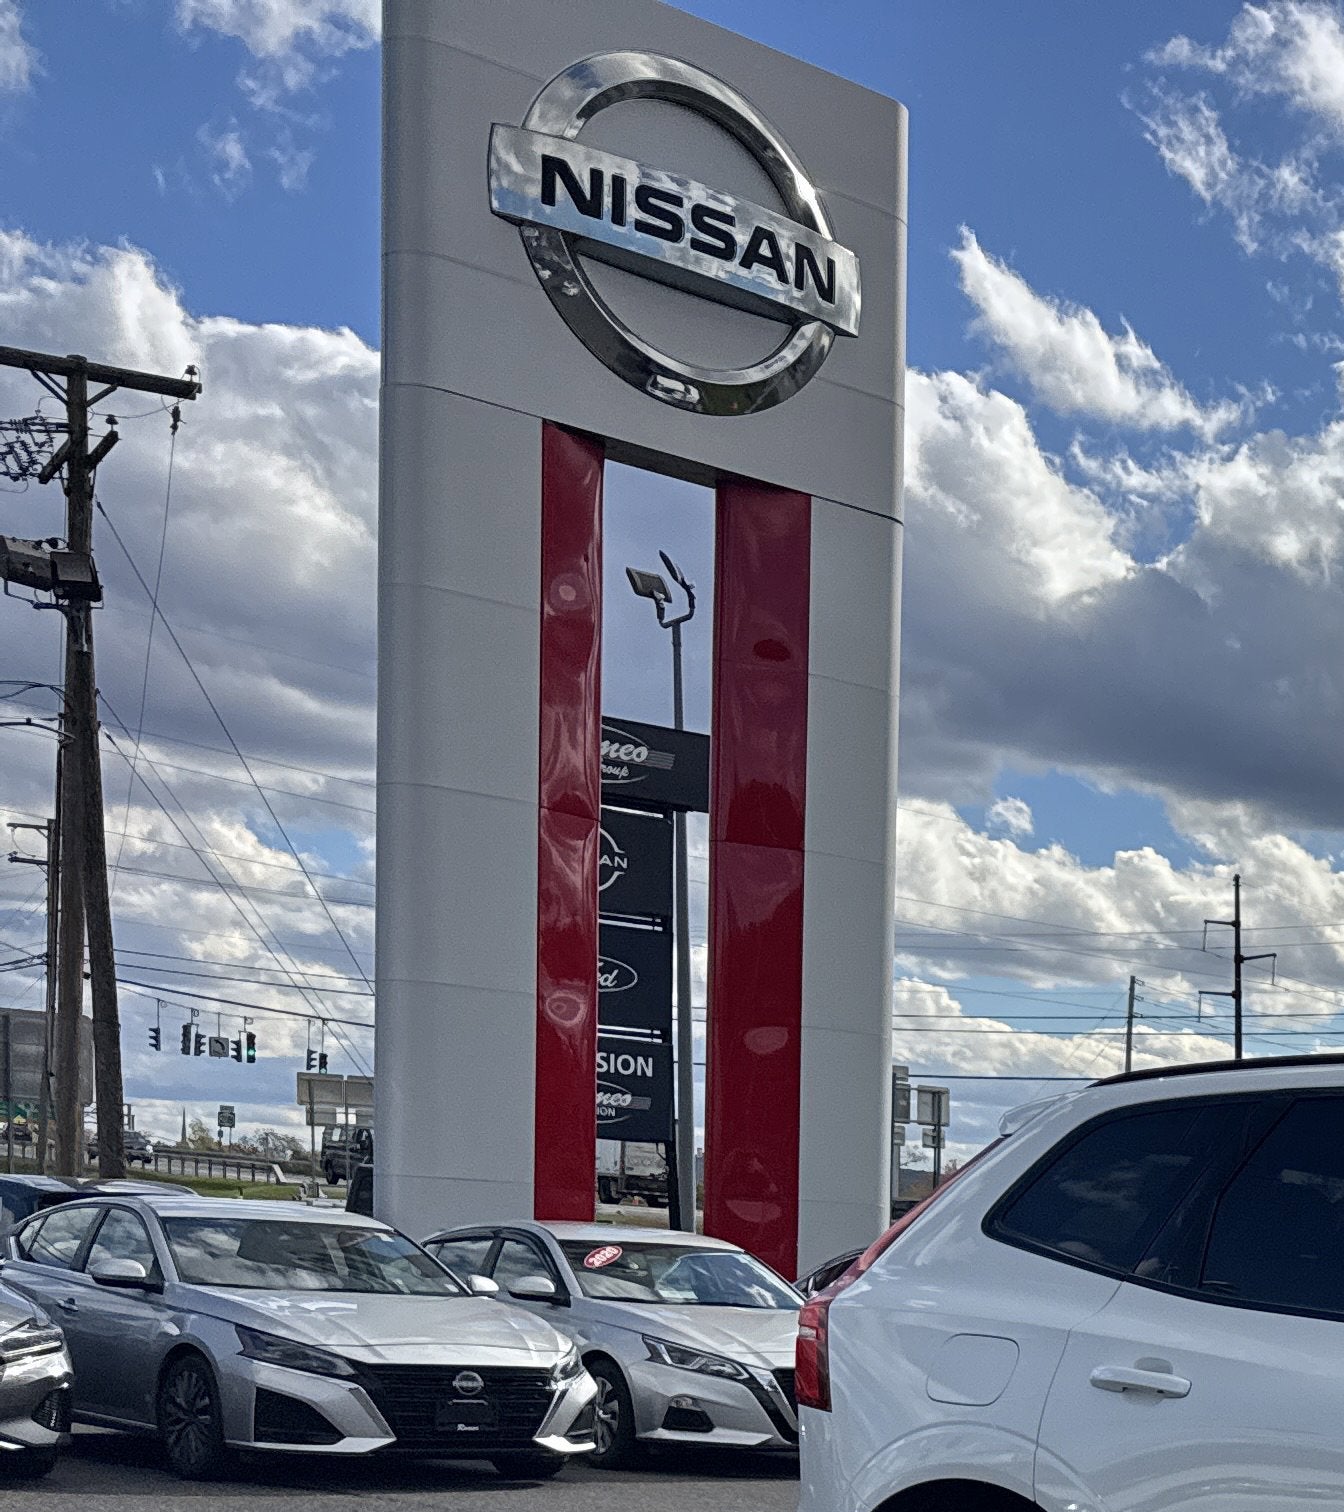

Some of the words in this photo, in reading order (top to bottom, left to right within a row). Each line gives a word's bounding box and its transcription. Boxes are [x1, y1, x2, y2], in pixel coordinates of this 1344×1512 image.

[541, 154, 836, 305] NISSAN
[600, 854, 628, 869] AN
[597, 1051, 653, 1077] SION
[597, 1106, 616, 1117] ION
